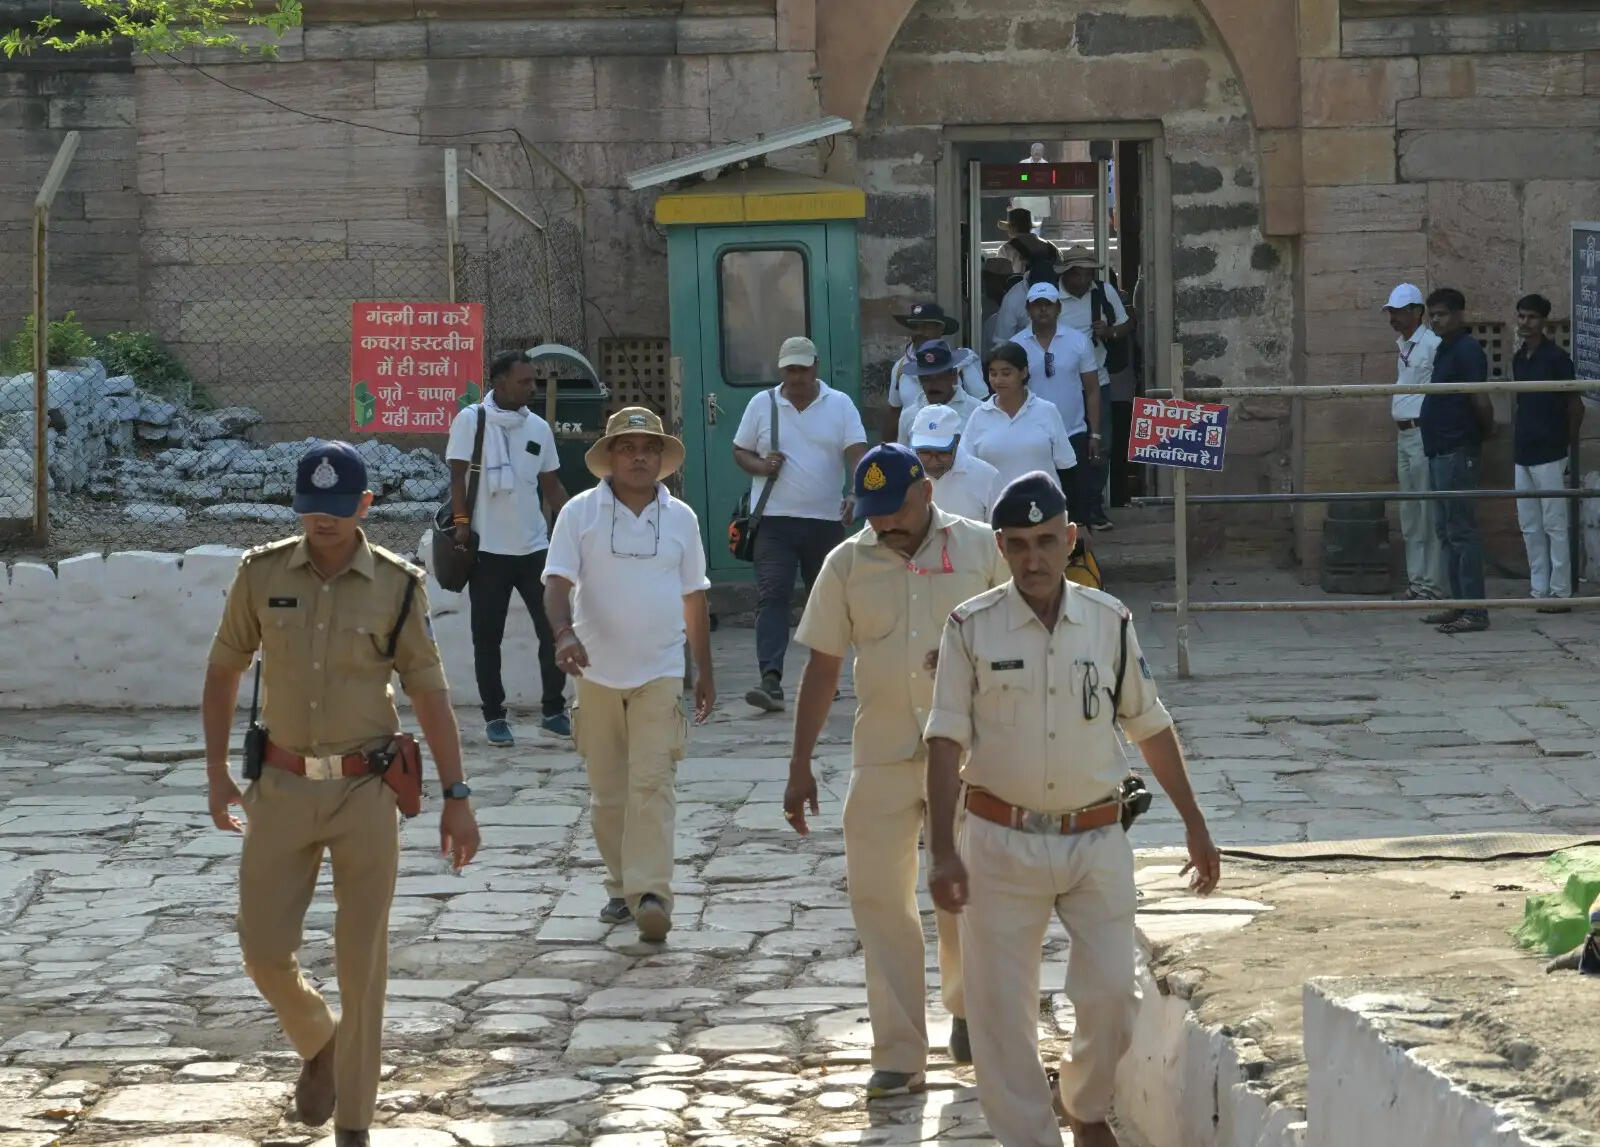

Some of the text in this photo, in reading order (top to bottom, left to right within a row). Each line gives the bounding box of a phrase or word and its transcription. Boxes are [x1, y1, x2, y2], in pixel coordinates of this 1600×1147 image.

[366, 305, 471, 326] गंदगी ना करें
[360, 330, 475, 351] कचरा डस्टबीन
[377, 356, 394, 376] में
[397, 355, 414, 377] ही
[378, 382, 402, 407] जूते
[418, 387, 456, 402] चप्पल
[1143, 400, 1219, 424] मोबाईल
[554, 421, 583, 434] tex
